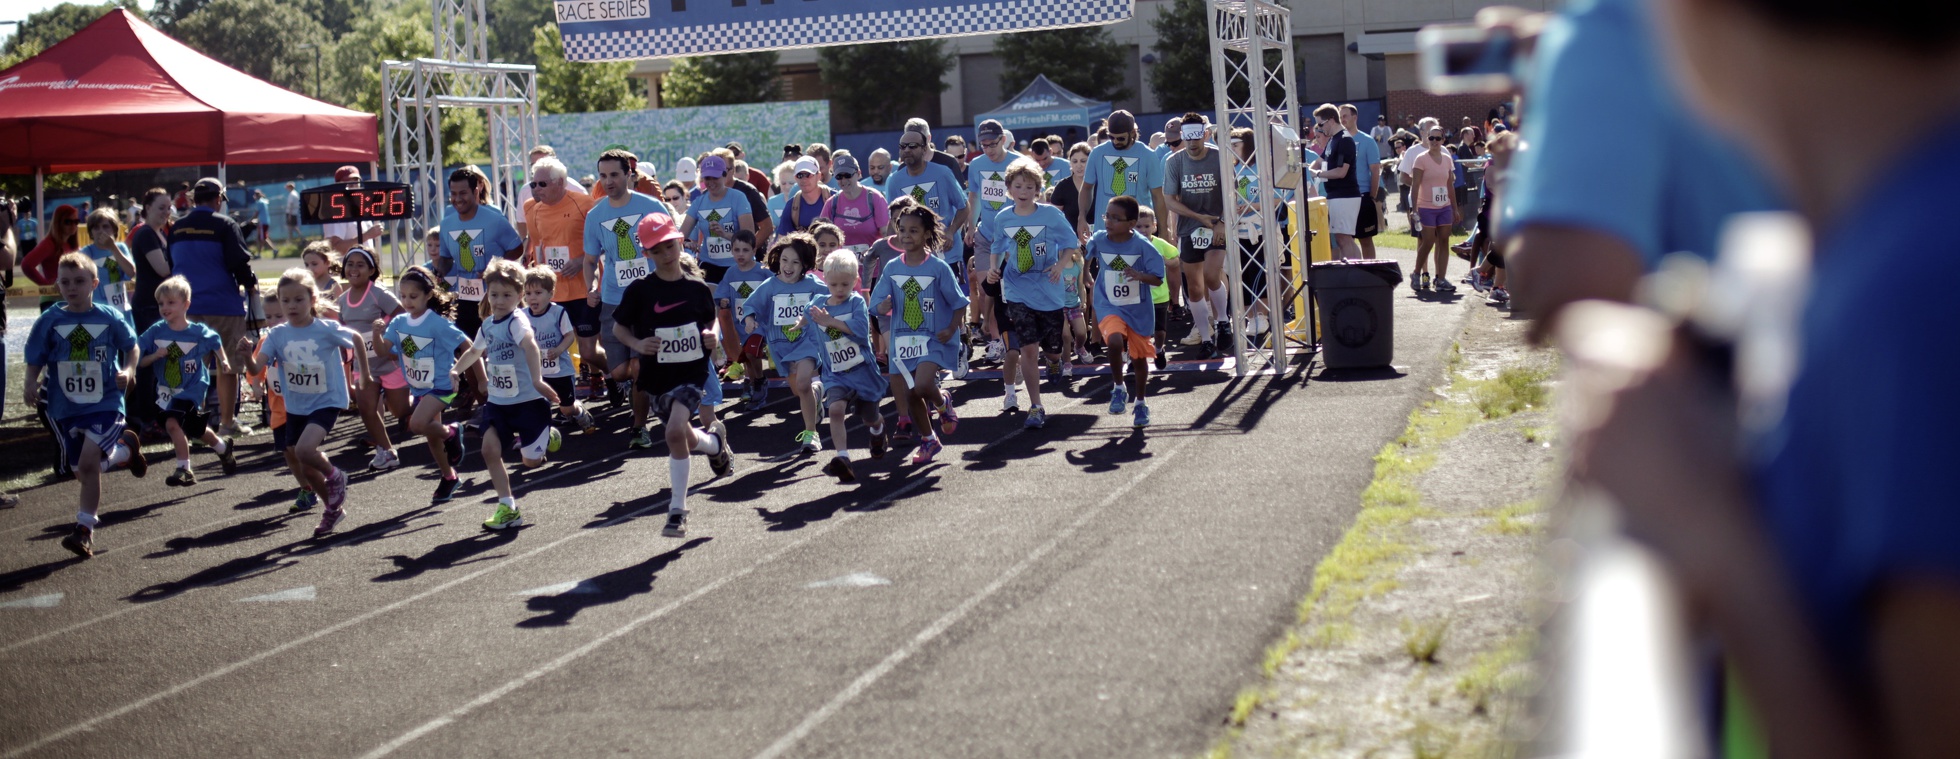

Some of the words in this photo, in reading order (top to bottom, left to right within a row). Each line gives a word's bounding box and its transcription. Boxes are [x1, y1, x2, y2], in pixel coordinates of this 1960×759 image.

[557, 2, 595, 20] RACE
[600, 0, 647, 19] SERIES
[1128, 174, 1138, 182] 5K
[1182, 180, 1218, 189] BOSTON.
[984, 187, 1003, 196] 2038
[331, 190, 404, 219] 57:26
[930, 200, 939, 208] 5K
[474, 247, 484, 256] 5K
[710, 243, 731, 253] 2019
[1035, 246, 1046, 256] 5K
[548, 259, 565, 270] 598
[619, 266, 645, 280] 2006
[461, 286, 480, 296] 2081
[1113, 285, 1130, 298] 69
[778, 305, 804, 318] 2039
[922, 301, 934, 312] 5K
[662, 336, 697, 353] 2080
[95, 350, 107, 362] 5K
[830, 346, 856, 364] 2009
[900, 345, 922, 358] 2001
[185, 363, 196, 373] 5K
[540, 359, 556, 368] 66
[288, 372, 319, 386] 2071
[405, 365, 429, 382] 2007
[65, 377, 96, 393] 619
